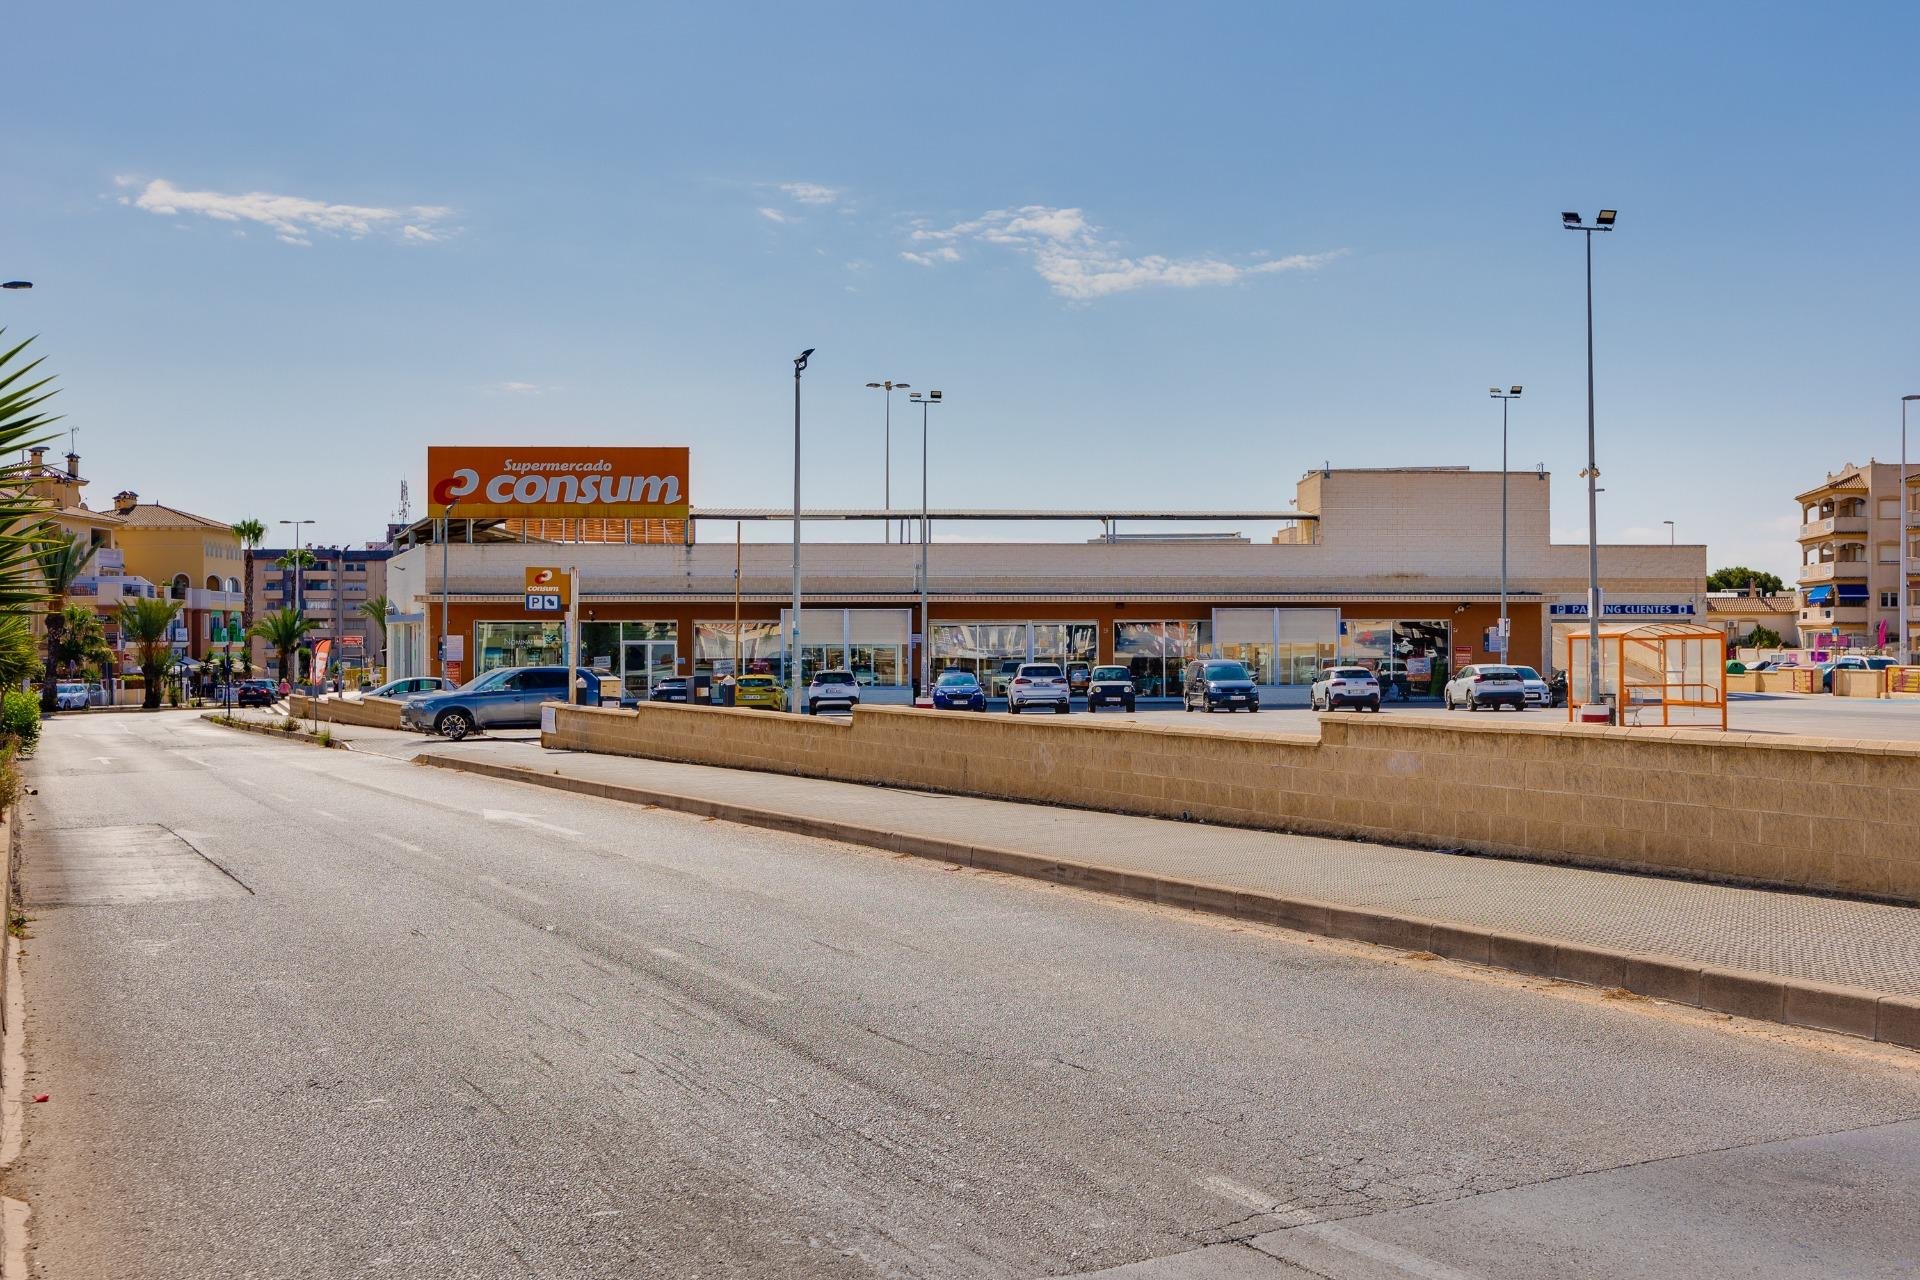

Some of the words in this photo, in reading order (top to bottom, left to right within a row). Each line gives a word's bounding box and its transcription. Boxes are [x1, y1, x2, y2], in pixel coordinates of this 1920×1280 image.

[504, 459, 612, 474] Supermercado
[486, 474, 682, 505] consum
[532, 597, 540, 607] P
[1572, 605, 1621, 614] PANG
[1625, 605, 1672, 614] CLIENTES
